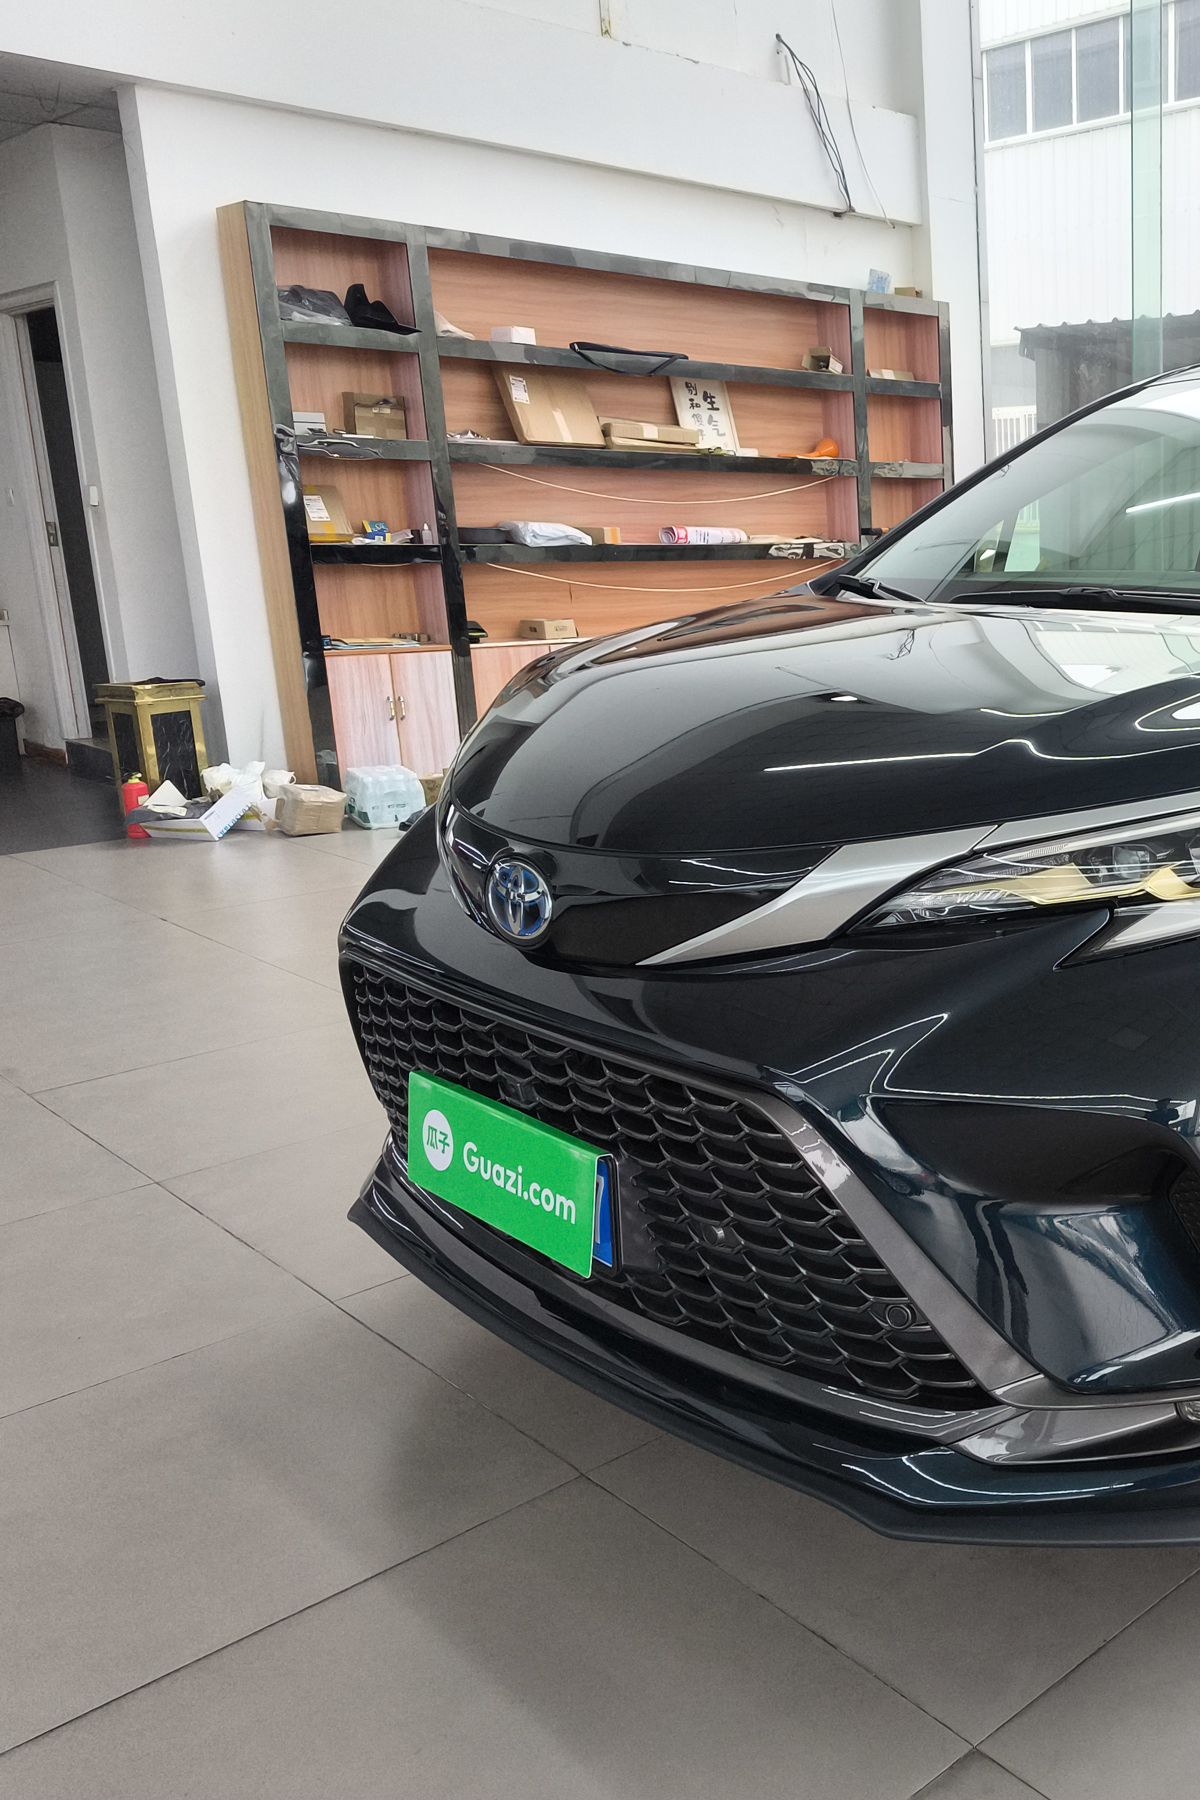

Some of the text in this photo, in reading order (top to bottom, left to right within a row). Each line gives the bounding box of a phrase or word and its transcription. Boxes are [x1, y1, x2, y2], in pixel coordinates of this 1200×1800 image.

[702, 390, 726, 437] 生气
[426, 1125, 450, 1154] 瓜子
[463, 1141, 576, 1225] Guazi.com
